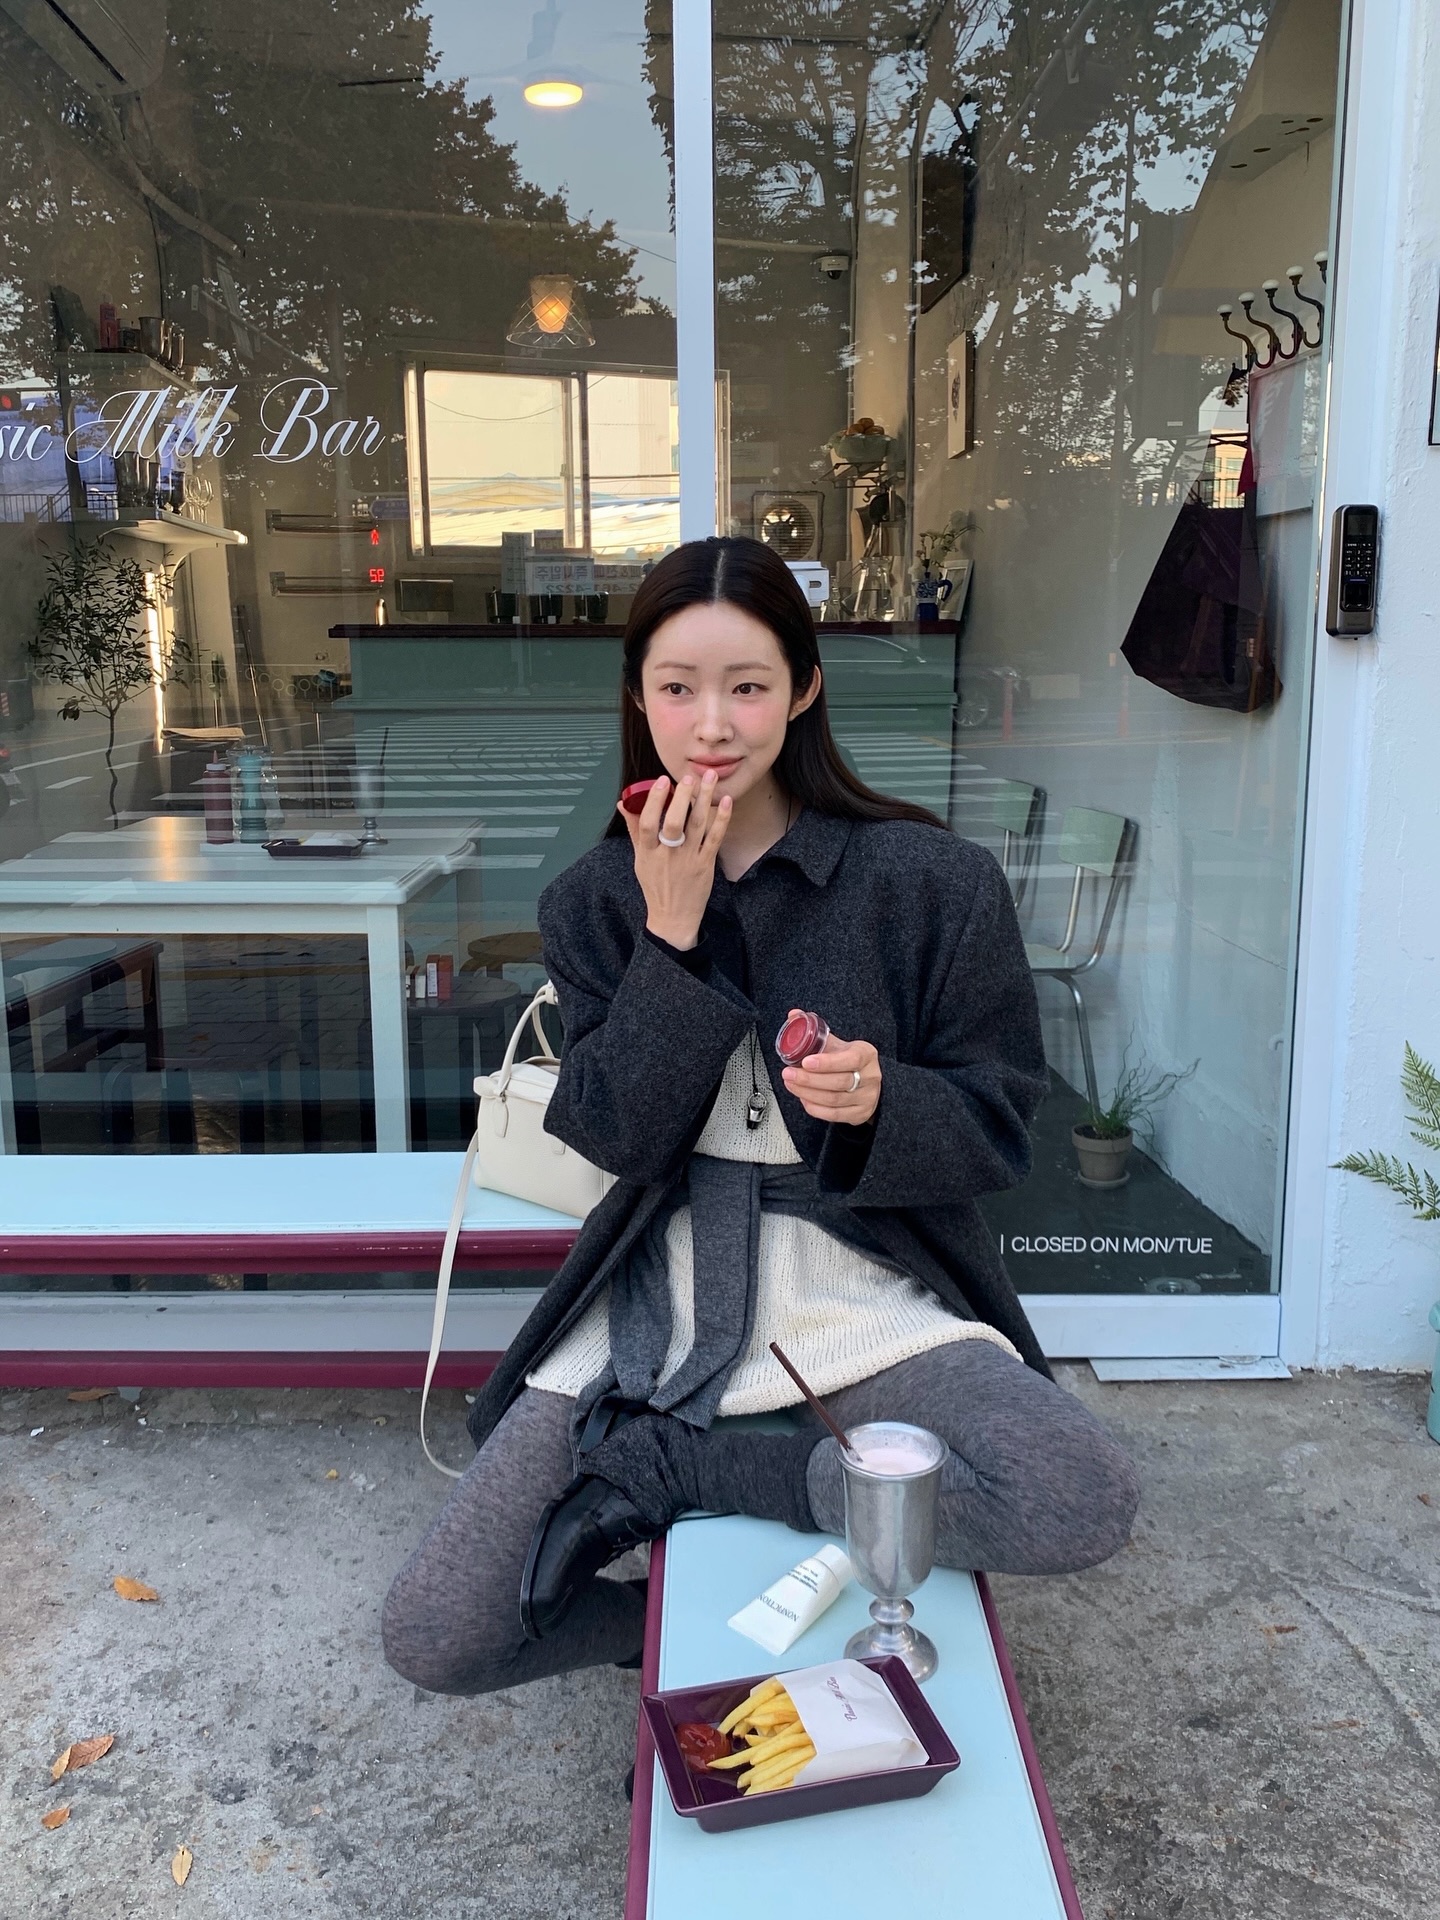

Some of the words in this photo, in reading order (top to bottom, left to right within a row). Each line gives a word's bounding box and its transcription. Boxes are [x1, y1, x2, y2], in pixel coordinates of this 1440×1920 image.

[65, 384, 239, 464] Milk
[252, 377, 386, 464] Bar
[1011, 1236, 1087, 1253] CLOSED
[1090, 1237, 1119, 1253] ON
[1123, 1237, 1213, 1254] MON/TUE
[757, 1594, 800, 1622] NONFICTION
